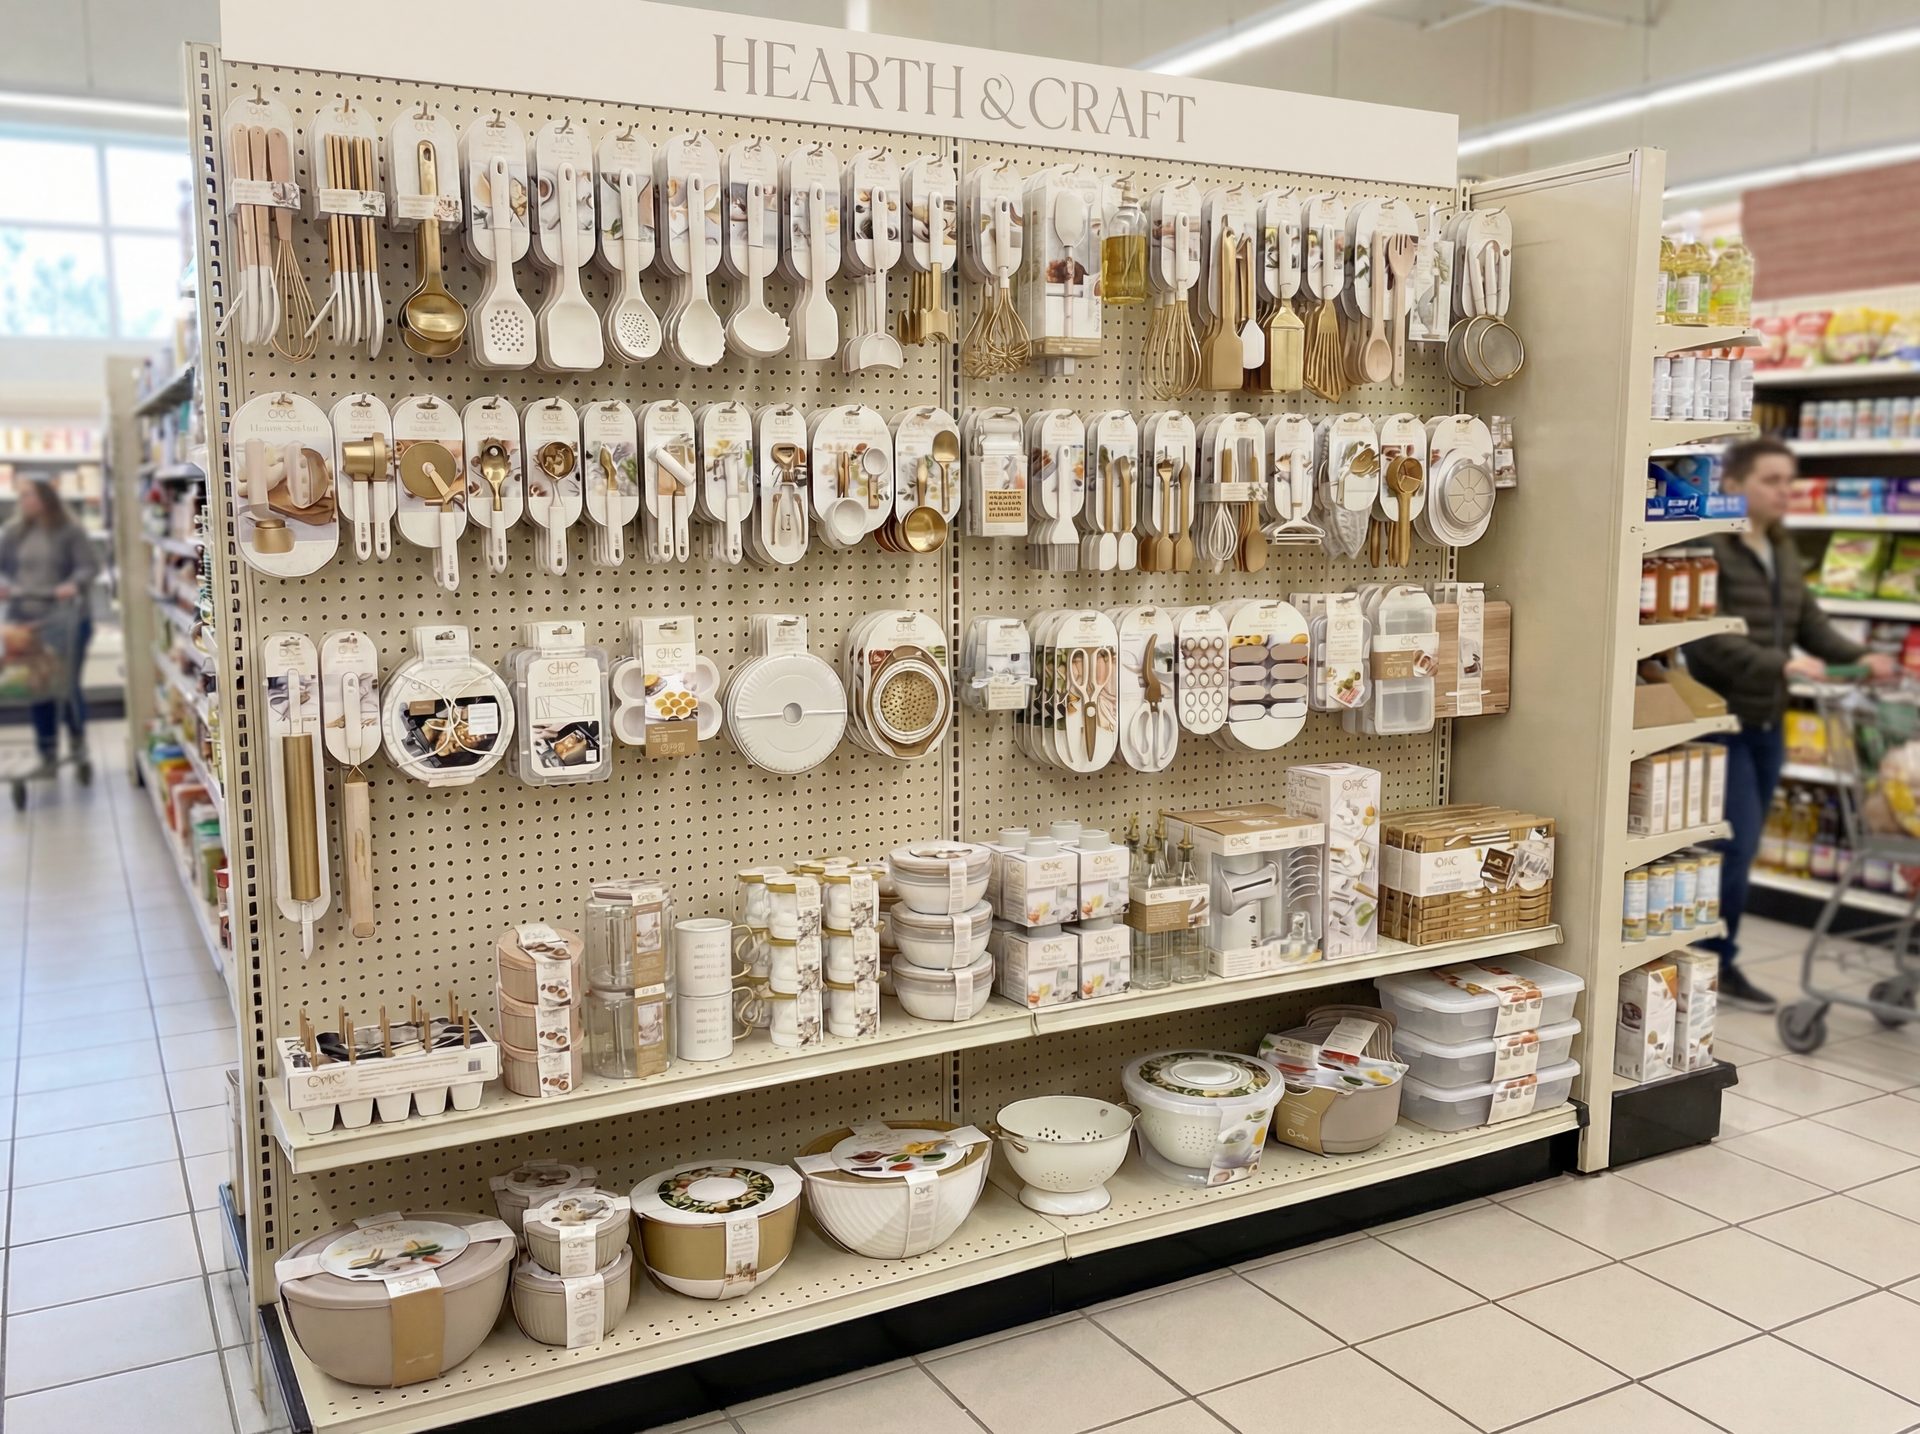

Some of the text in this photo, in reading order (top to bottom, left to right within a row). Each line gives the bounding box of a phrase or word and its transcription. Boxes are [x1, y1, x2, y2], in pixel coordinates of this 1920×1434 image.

[713, 34, 1196, 143] HEARTH & CRAFT
